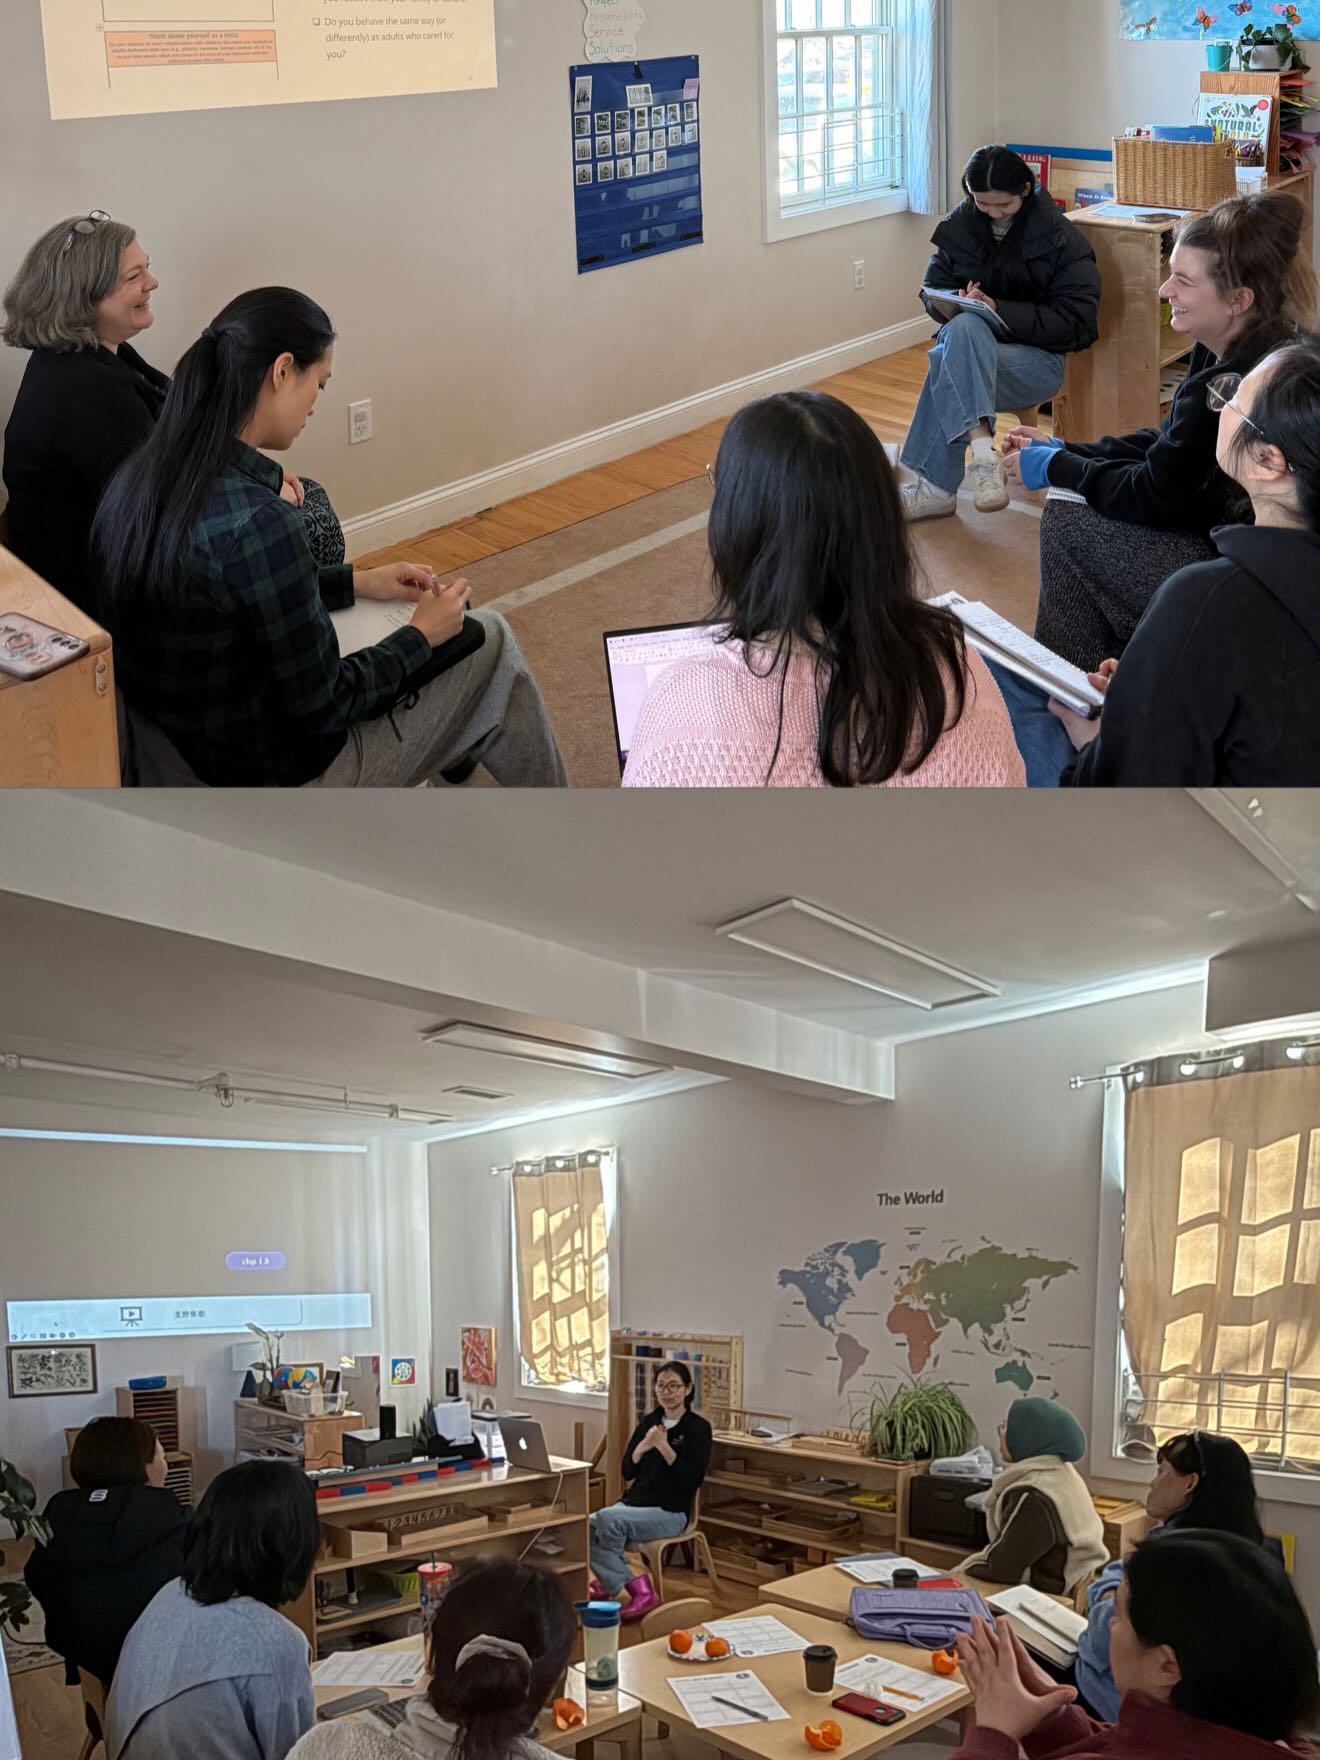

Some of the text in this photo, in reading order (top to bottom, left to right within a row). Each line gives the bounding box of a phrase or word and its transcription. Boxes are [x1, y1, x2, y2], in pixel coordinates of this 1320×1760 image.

[325, 18, 336, 26] Do
[338, 19, 353, 28] you
[356, 17, 383, 26] behave
[385, 17, 398, 25] the
[421, 19, 434, 27] way
[436, 17, 446, 26] (or
[325, 33, 369, 43] differently)
[381, 33, 404, 41] adults
[406, 32, 421, 40] who
[423, 32, 442, 40] cared
[444, 31, 454, 39] for
[588, 40, 633, 55] Solutions
[326, 50, 346, 60] you?
[877, 1188, 944, 1206] The World
